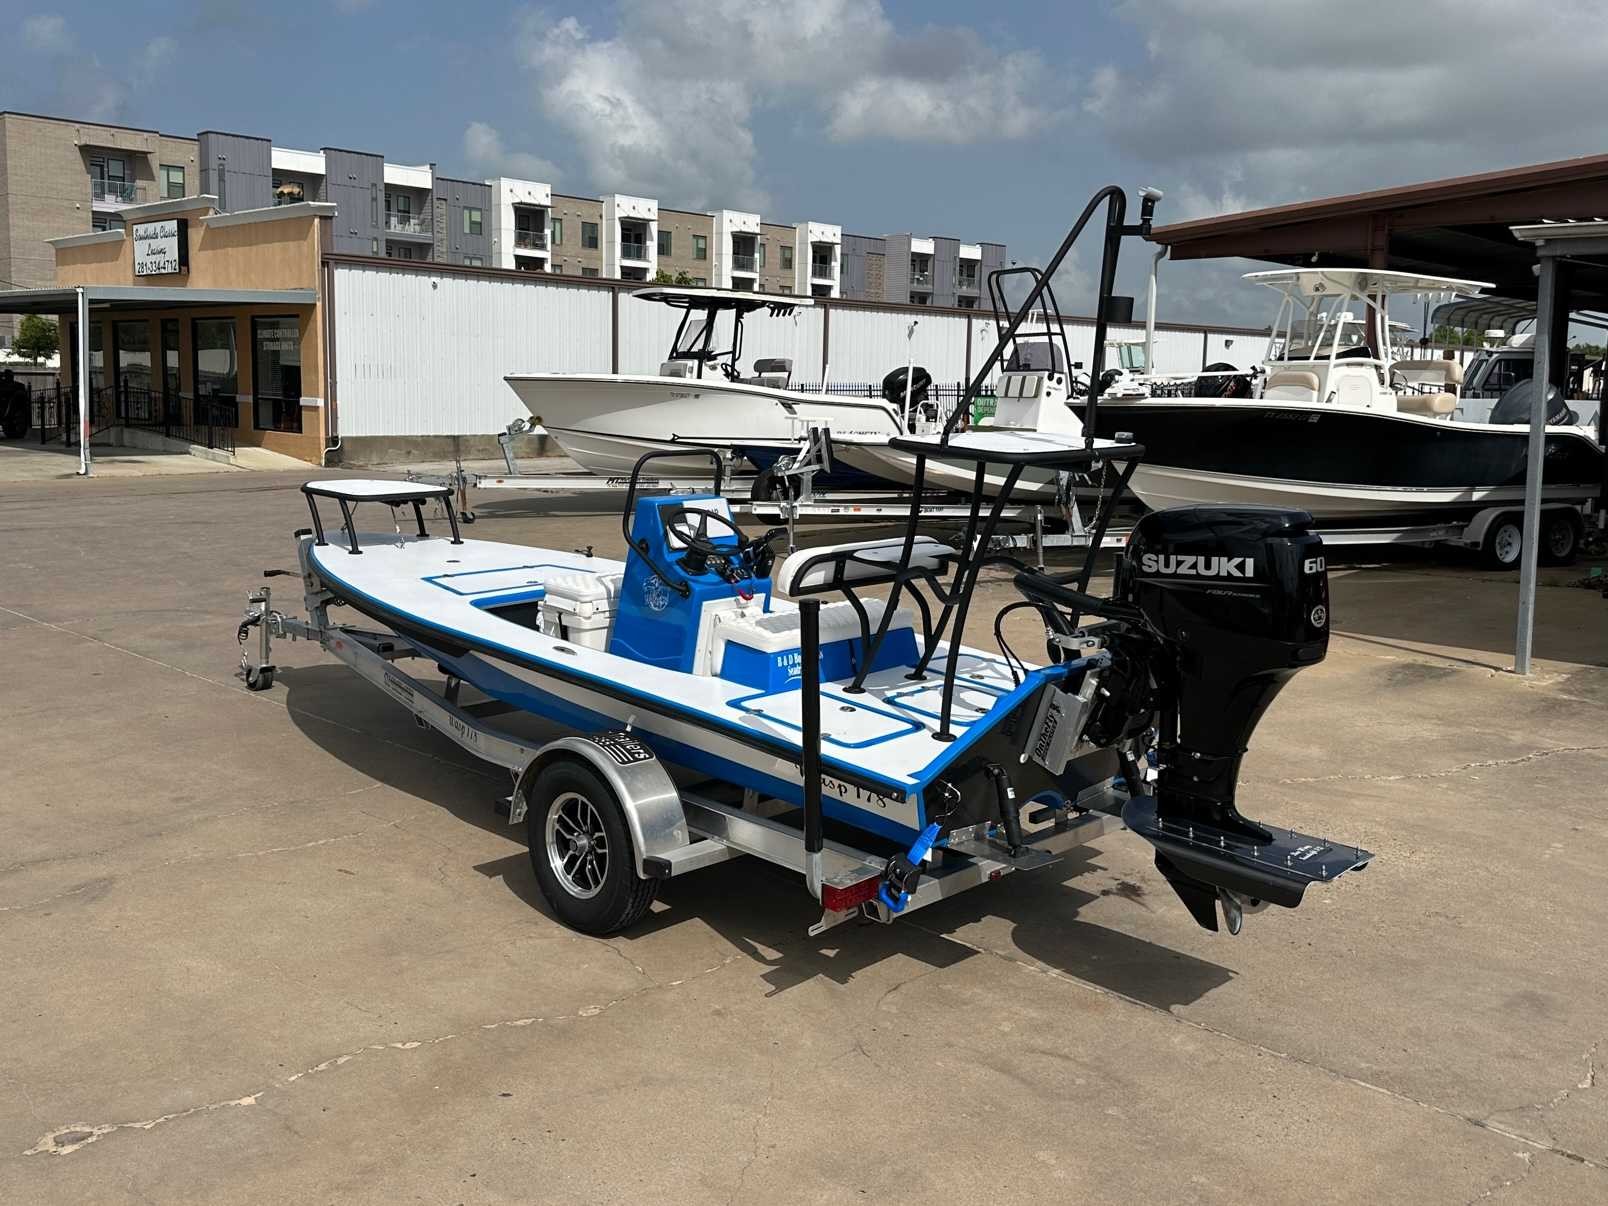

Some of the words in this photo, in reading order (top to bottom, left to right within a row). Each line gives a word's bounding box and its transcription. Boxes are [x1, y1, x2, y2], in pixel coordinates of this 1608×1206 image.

[137, 259, 177, 273] 281-334-4712
[1142, 553, 1254, 577] SUZUKI
[1304, 556, 1326, 574] 60
[855, 785, 887, 808] 178
